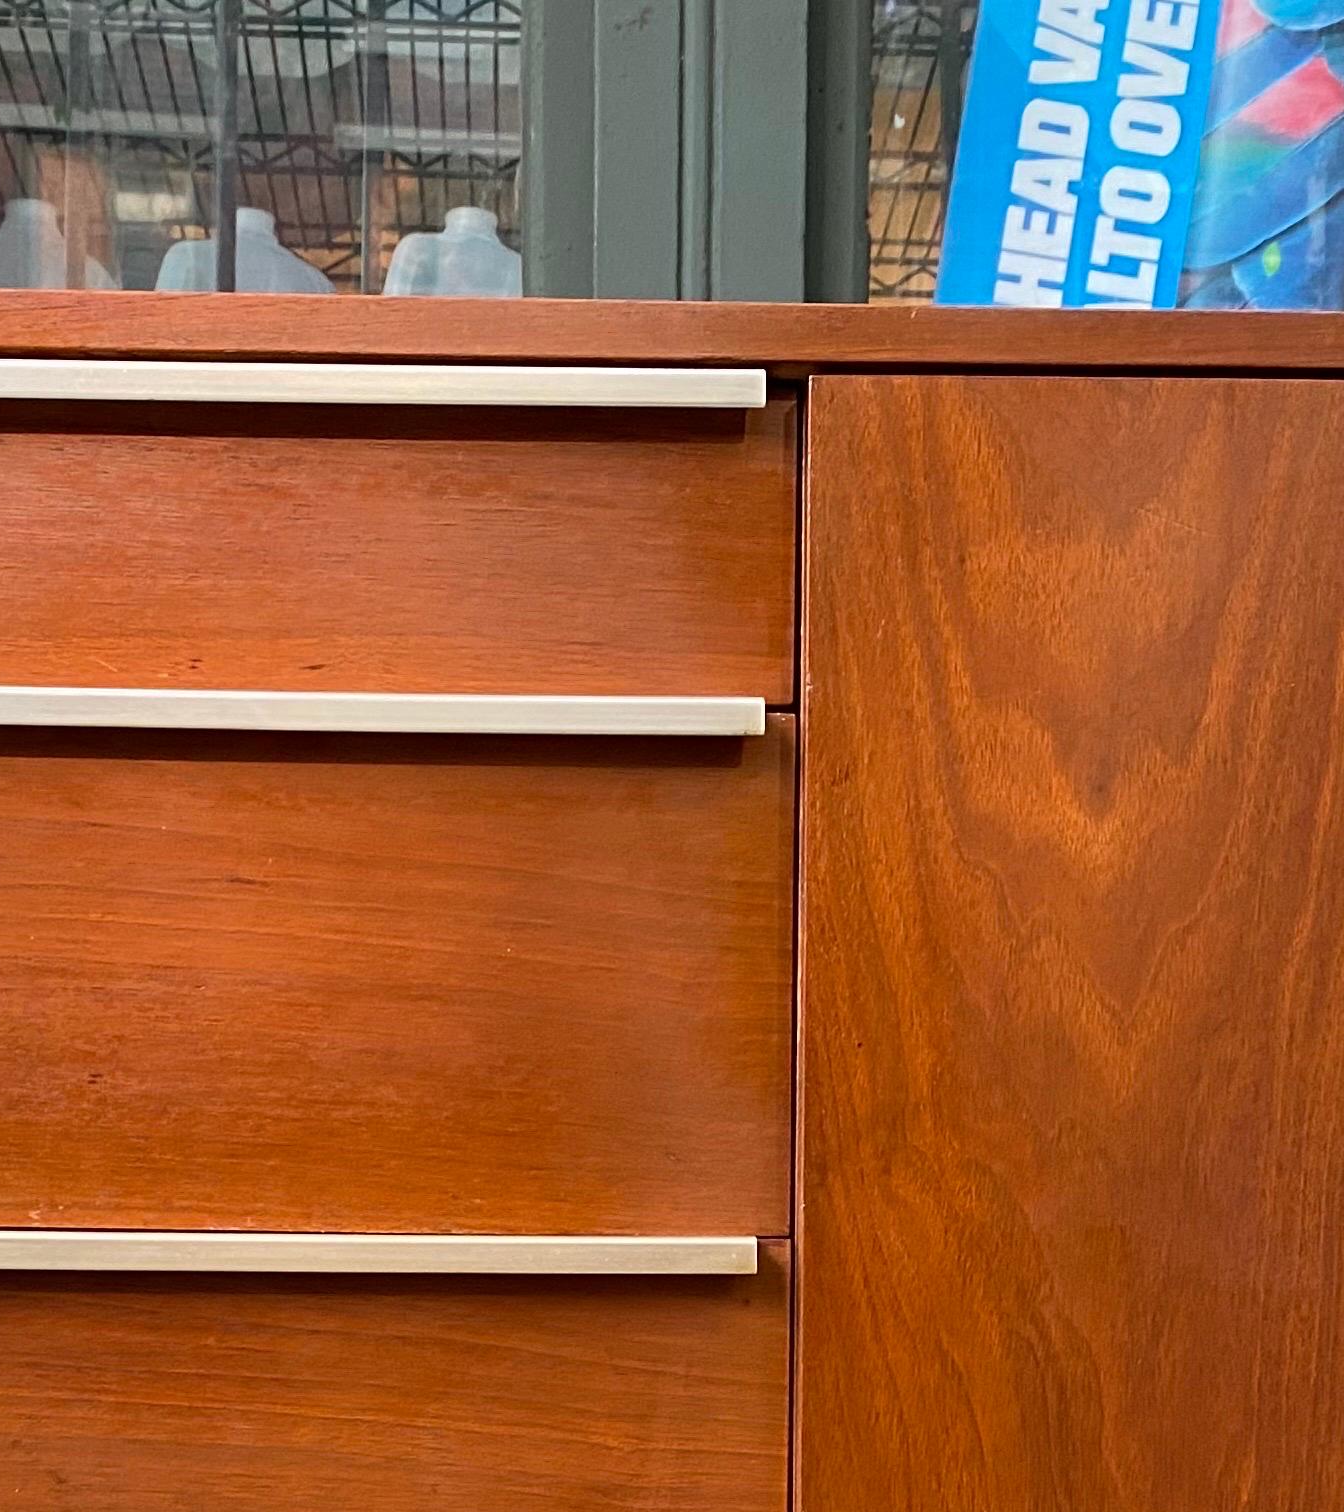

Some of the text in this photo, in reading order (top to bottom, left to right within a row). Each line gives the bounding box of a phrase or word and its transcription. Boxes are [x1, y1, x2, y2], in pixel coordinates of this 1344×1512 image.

[992, 97, 1090, 308] HEAD
[1083, 0, 1200, 309] LTO OVE
